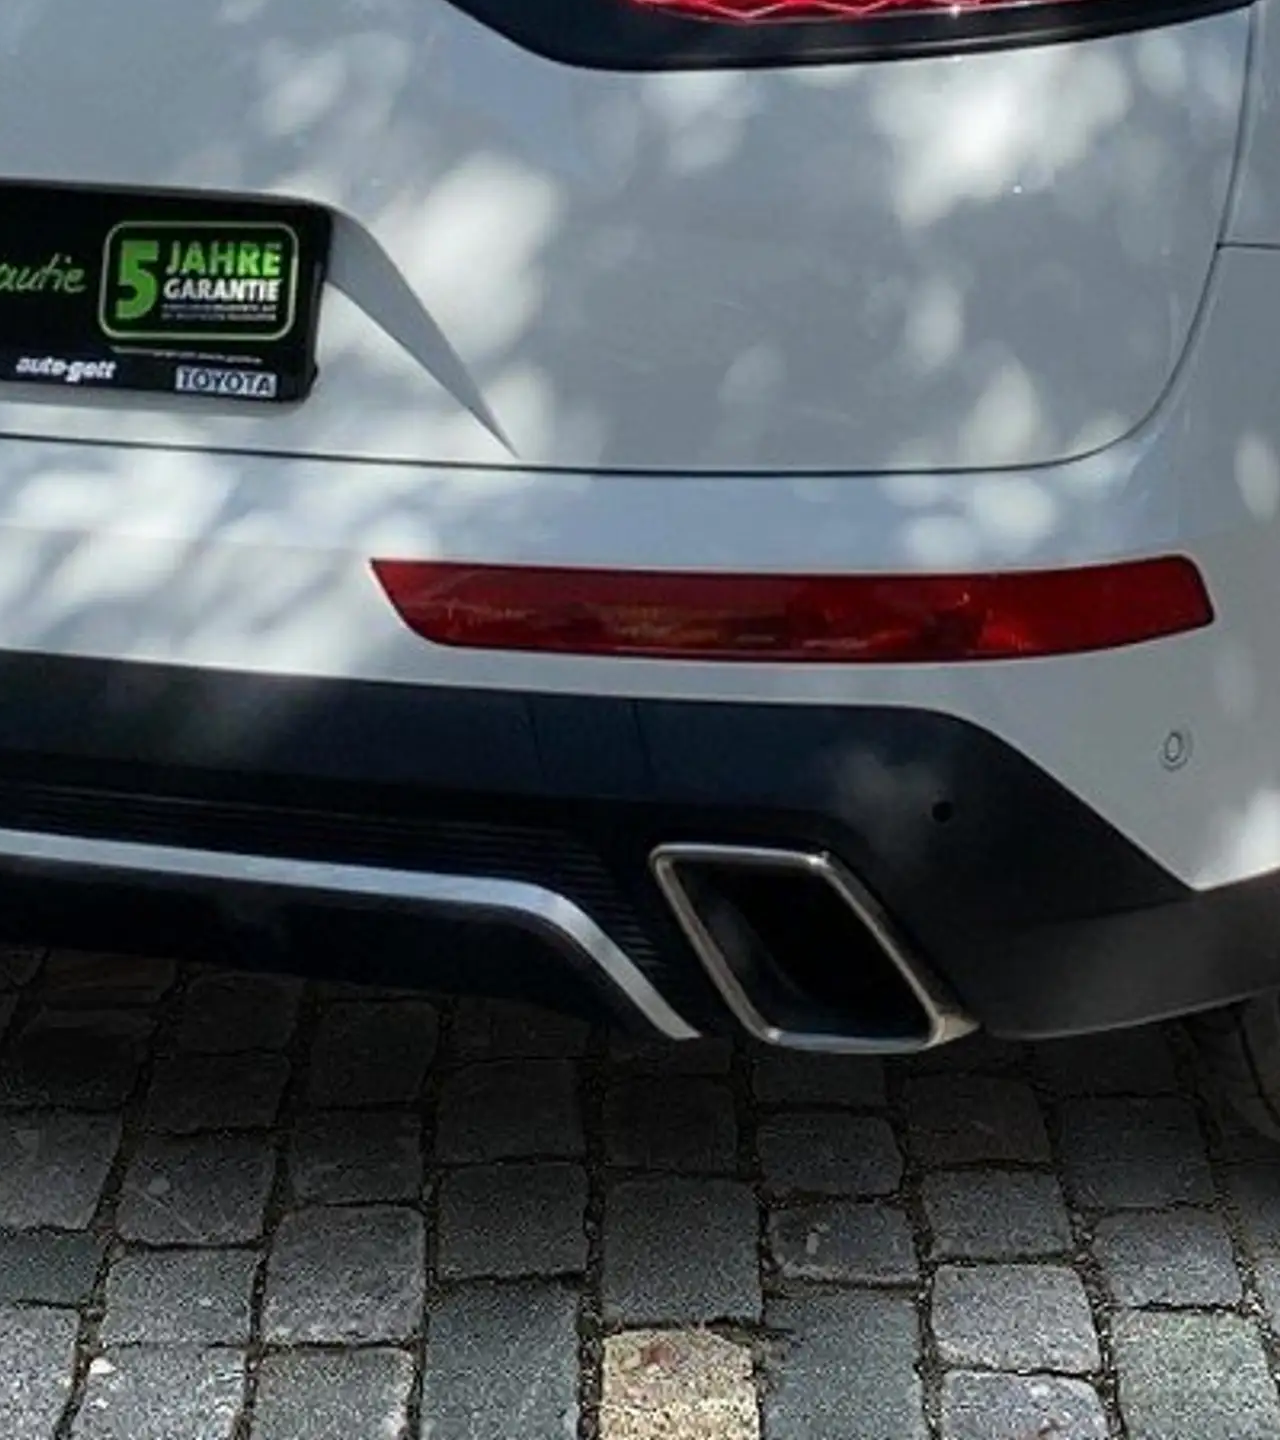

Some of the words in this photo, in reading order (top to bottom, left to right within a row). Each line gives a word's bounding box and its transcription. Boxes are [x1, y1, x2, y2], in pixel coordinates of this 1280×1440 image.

[115, 240, 160, 320] 5
[165, 240, 282, 277] JAHRE
[162, 277, 281, 303] GARANTIE
[181, 367, 271, 394] TOYOTA
